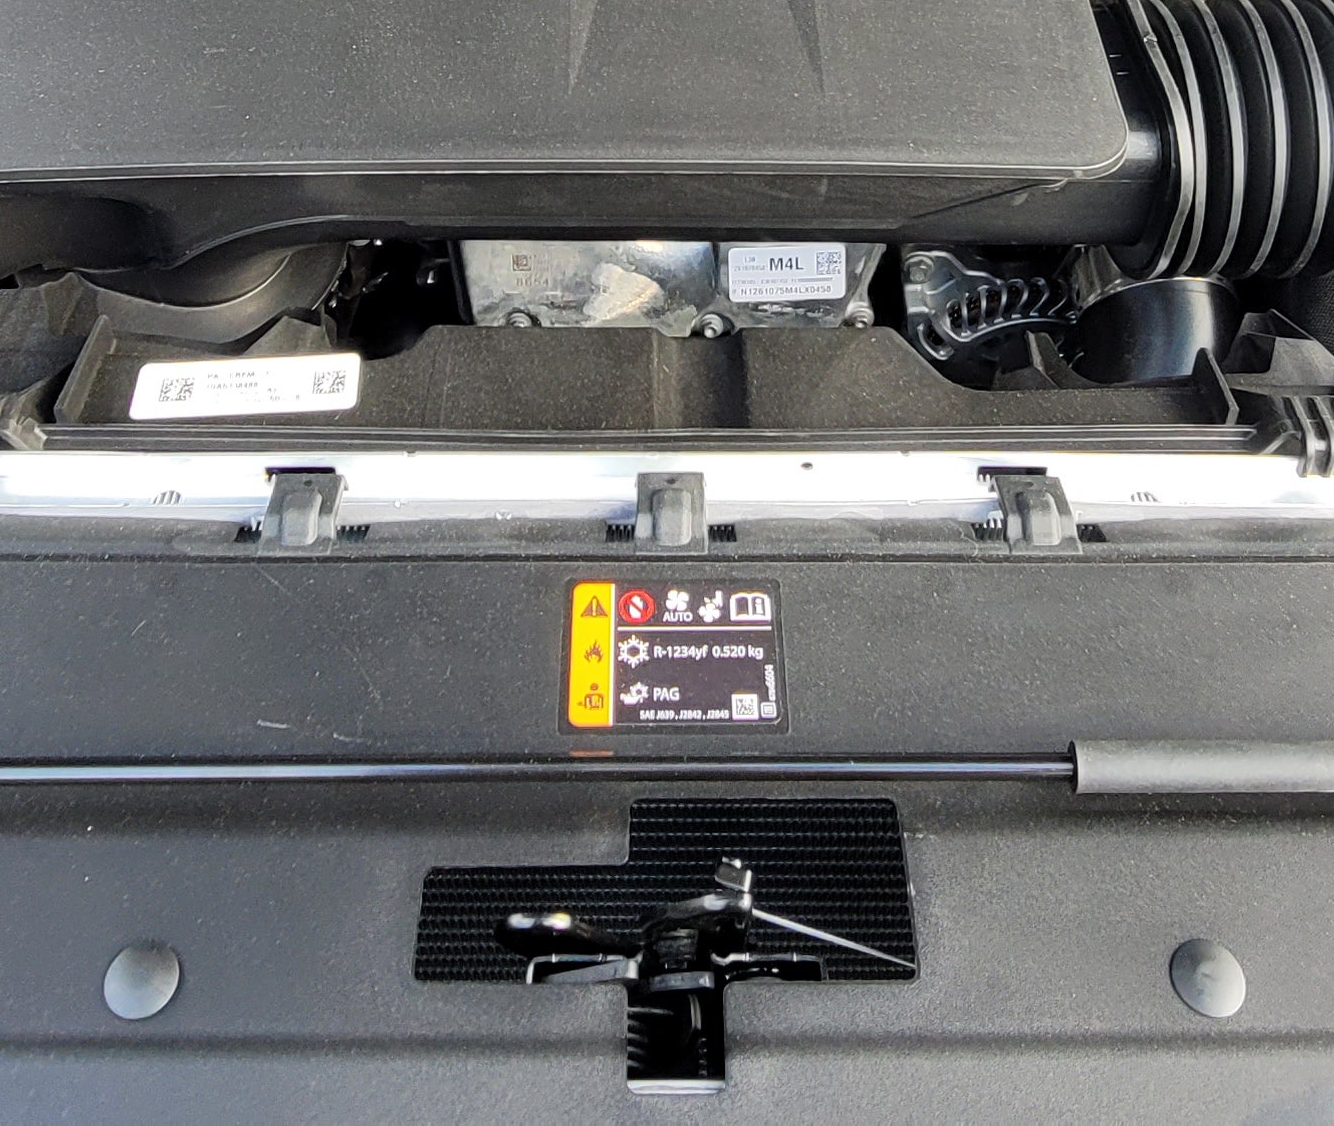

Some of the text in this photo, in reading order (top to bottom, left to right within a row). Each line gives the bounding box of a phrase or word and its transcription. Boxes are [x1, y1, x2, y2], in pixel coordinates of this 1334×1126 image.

[769, 257, 804, 271] M4L
[663, 611, 693, 622] AUTO
[653, 645, 764, 661] R-1234yf 0.520 kg
[653, 687, 680, 701] PAG
[639, 709, 656, 720] SAE
